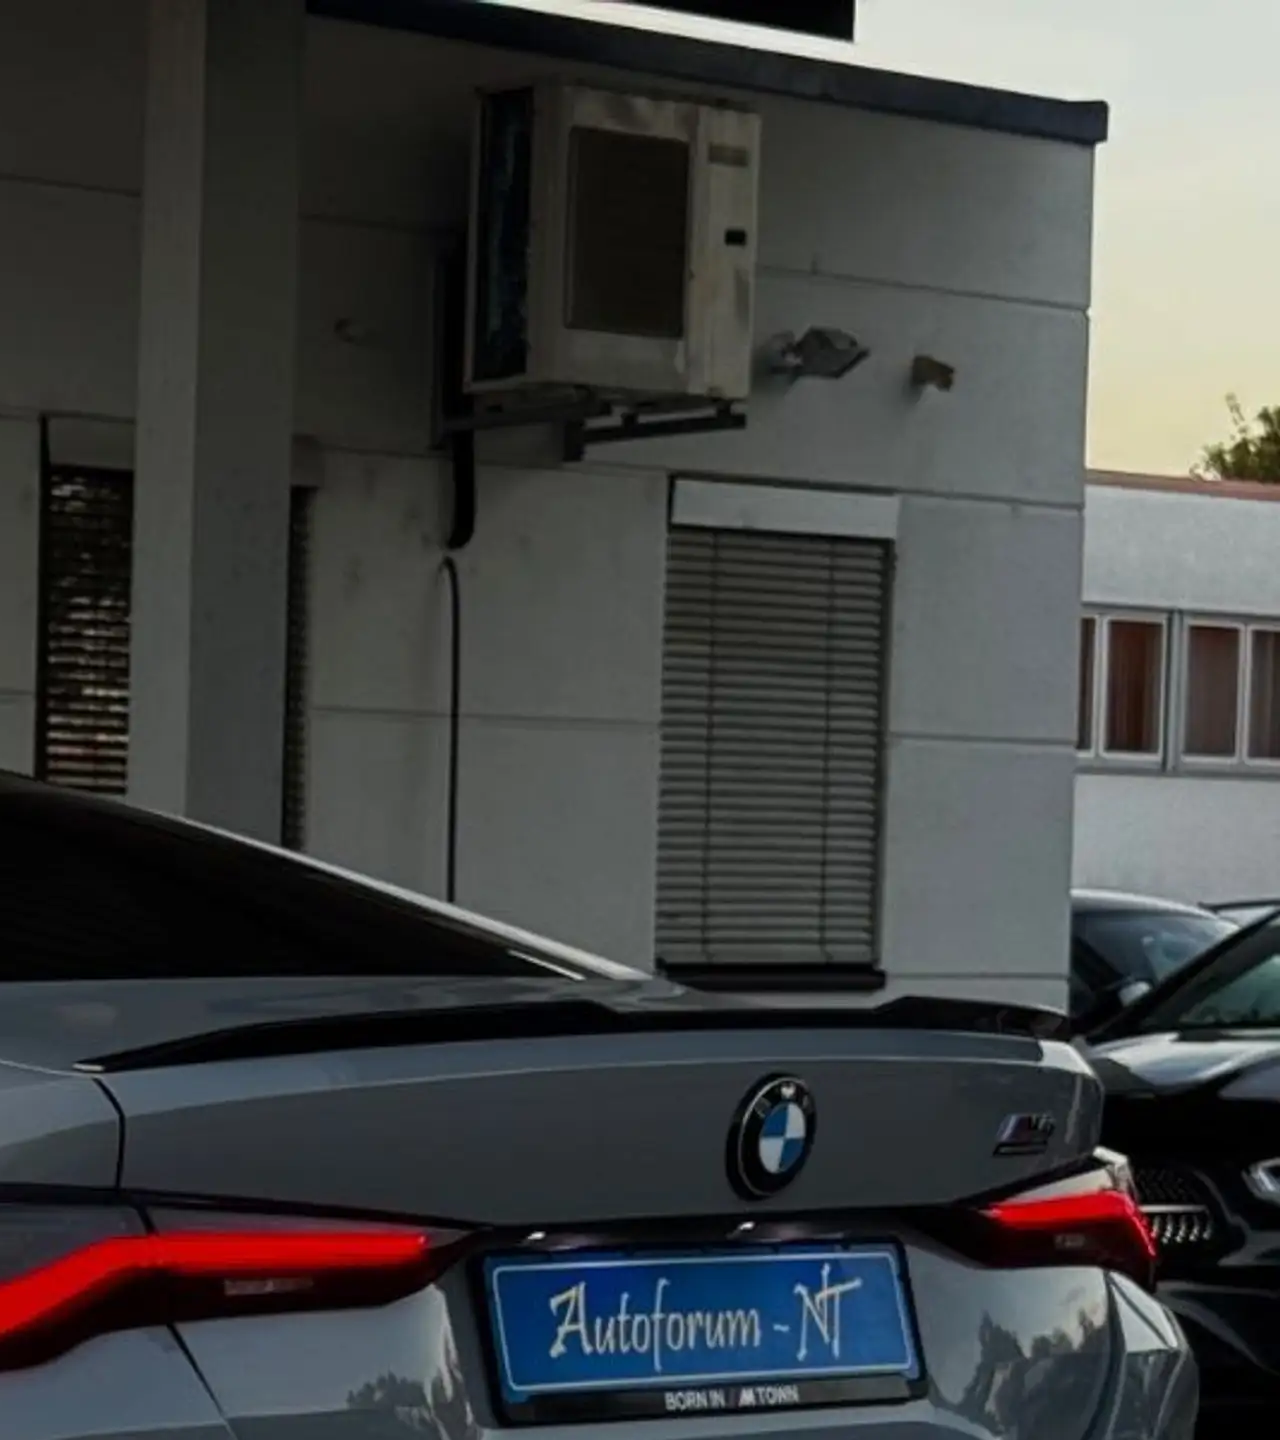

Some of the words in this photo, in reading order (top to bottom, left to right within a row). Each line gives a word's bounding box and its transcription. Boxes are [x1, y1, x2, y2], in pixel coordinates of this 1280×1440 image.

[548, 1277, 761, 1374] Autoforum
[664, 1390, 708, 1412] BORN
[755, 1384, 800, 1405] TOWN
